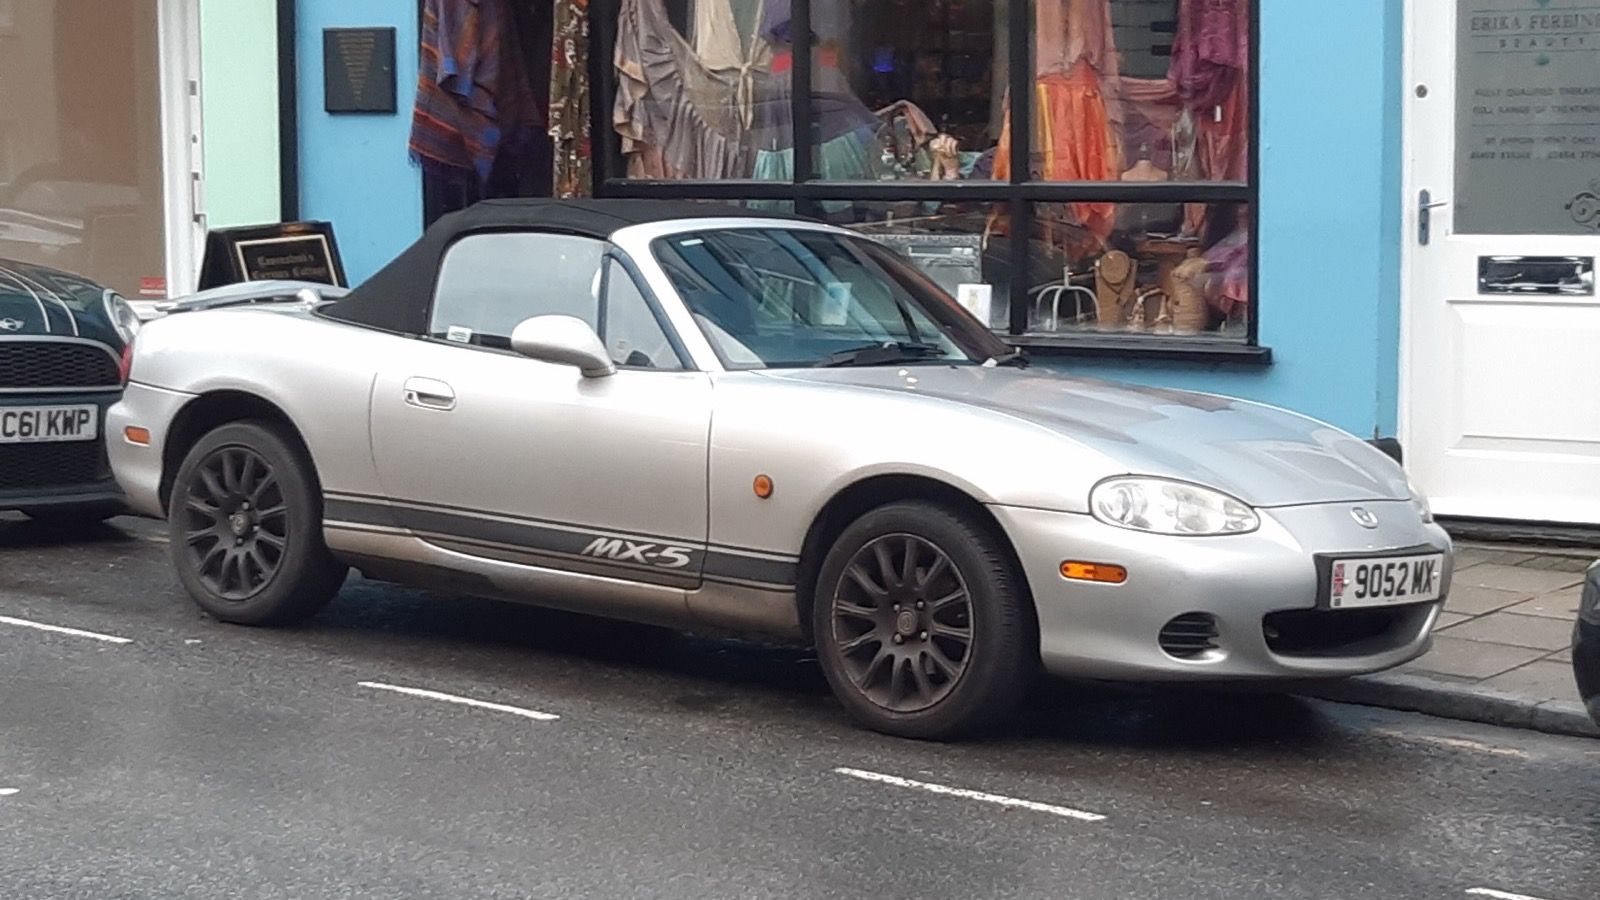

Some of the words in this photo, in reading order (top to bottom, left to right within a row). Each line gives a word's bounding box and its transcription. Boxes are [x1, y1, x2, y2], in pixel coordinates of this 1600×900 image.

[1471, 16, 1522, 31] ERIKA
[1499, 37, 1584, 49] BEAUTY
[2, 411, 40, 437] C61
[46, 409, 90, 436] KWP
[581, 537, 693, 568] MX-5
[1355, 563, 1408, 598] 9052
[1410, 559, 1436, 595] MX
